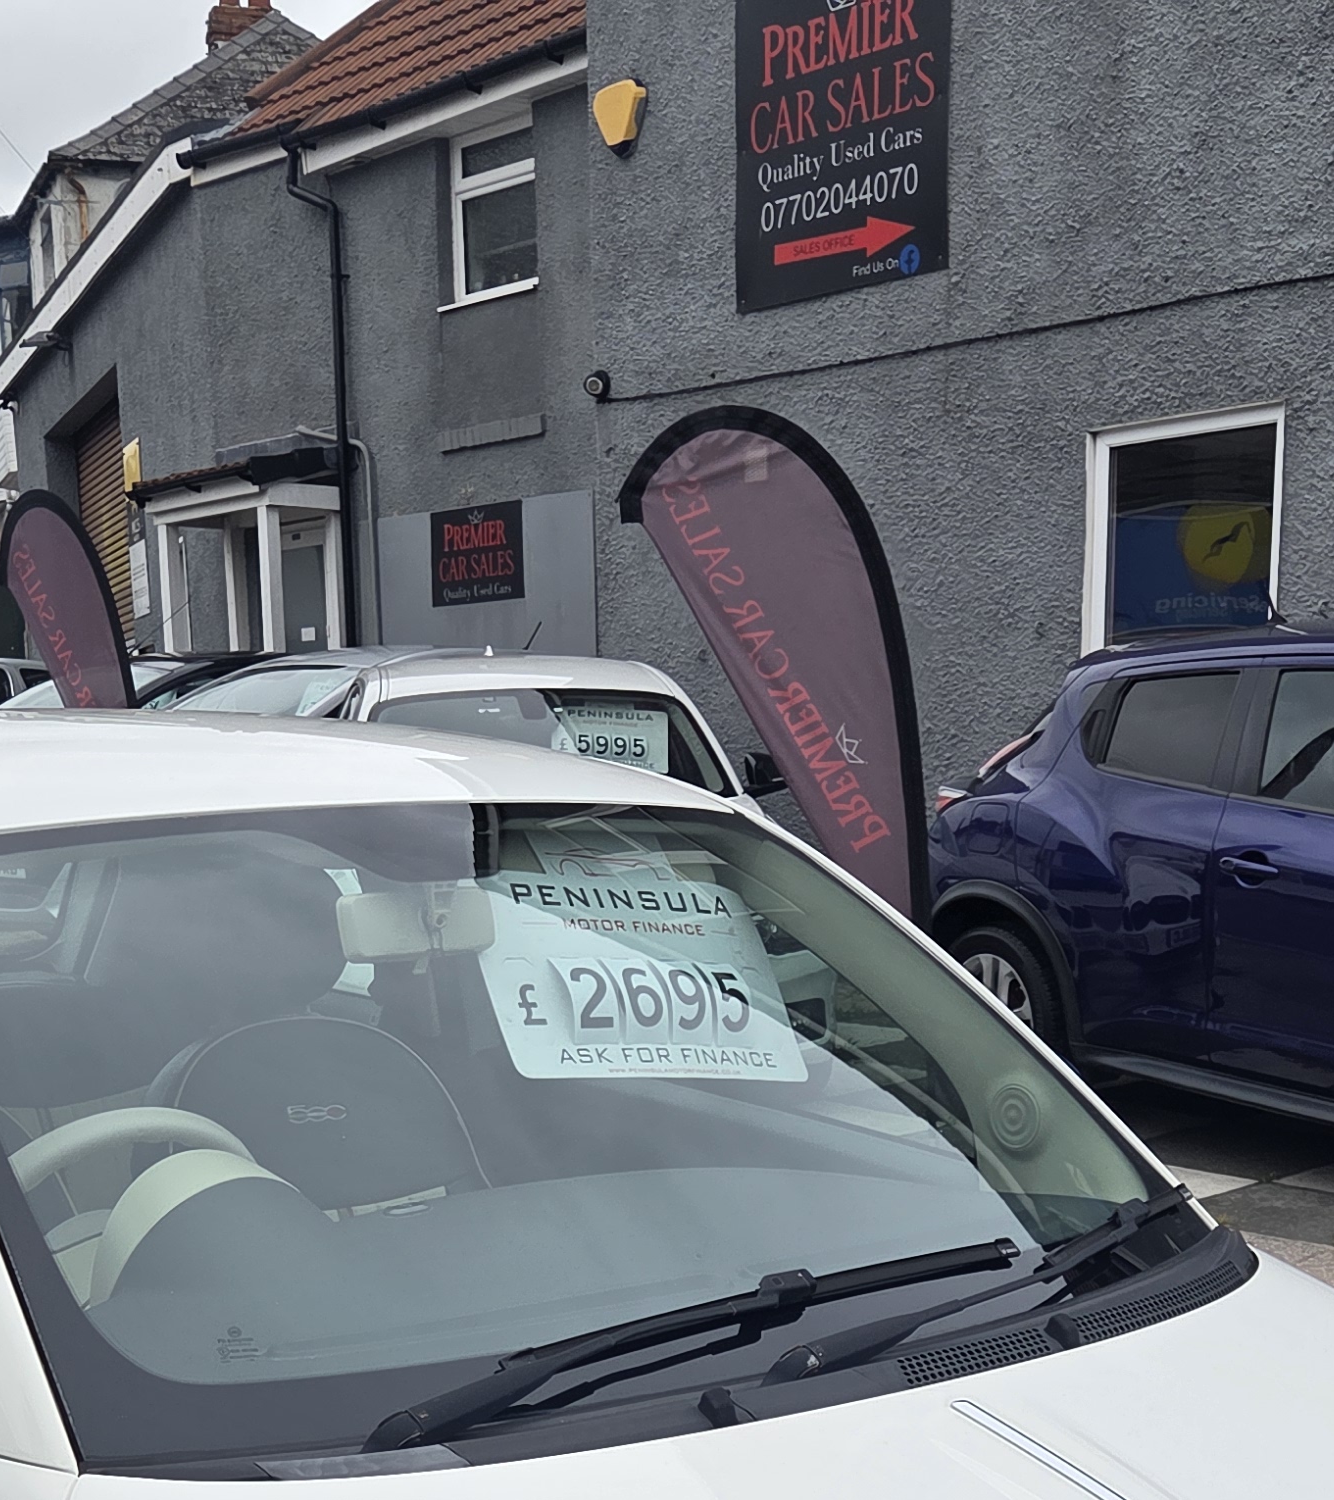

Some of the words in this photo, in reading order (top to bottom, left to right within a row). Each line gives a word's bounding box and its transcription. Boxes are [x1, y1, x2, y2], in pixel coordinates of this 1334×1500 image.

[761, 0, 919, 88] PREMIER
[750, 90, 819, 154] CAR
[826, 52, 936, 133] SALES
[757, 153, 824, 192] Quality
[830, 132, 875, 167] Used
[880, 127, 923, 154] Cars
[760, 163, 919, 233] 07702044070
[792, 241, 821, 257] SALES
[822, 234, 855, 252] OFFICE
[852, 263, 871, 278] Find
[872, 261, 885, 275] Us
[886, 258, 900, 271] On
[443, 519, 507, 552] PREMIER
[439, 556, 468, 583] CAR
[470, 549, 515, 579] SALES
[443, 586, 471, 603] Quality
[494, 582, 512, 595] Cars
[567, 709, 654, 721] PENINSULA
[577, 734, 646, 758] 5995
[509, 882, 733, 919] PENINSULA
[562, 917, 627, 933] MOTOR
[632, 920, 707, 937] FINANCE
[517, 983, 549, 1026] £
[569, 966, 750, 1033] 2695
[560, 1047, 614, 1065] ASK
[621, 1047, 674, 1064] FOR
[680, 1047, 778, 1069] FINANCE
